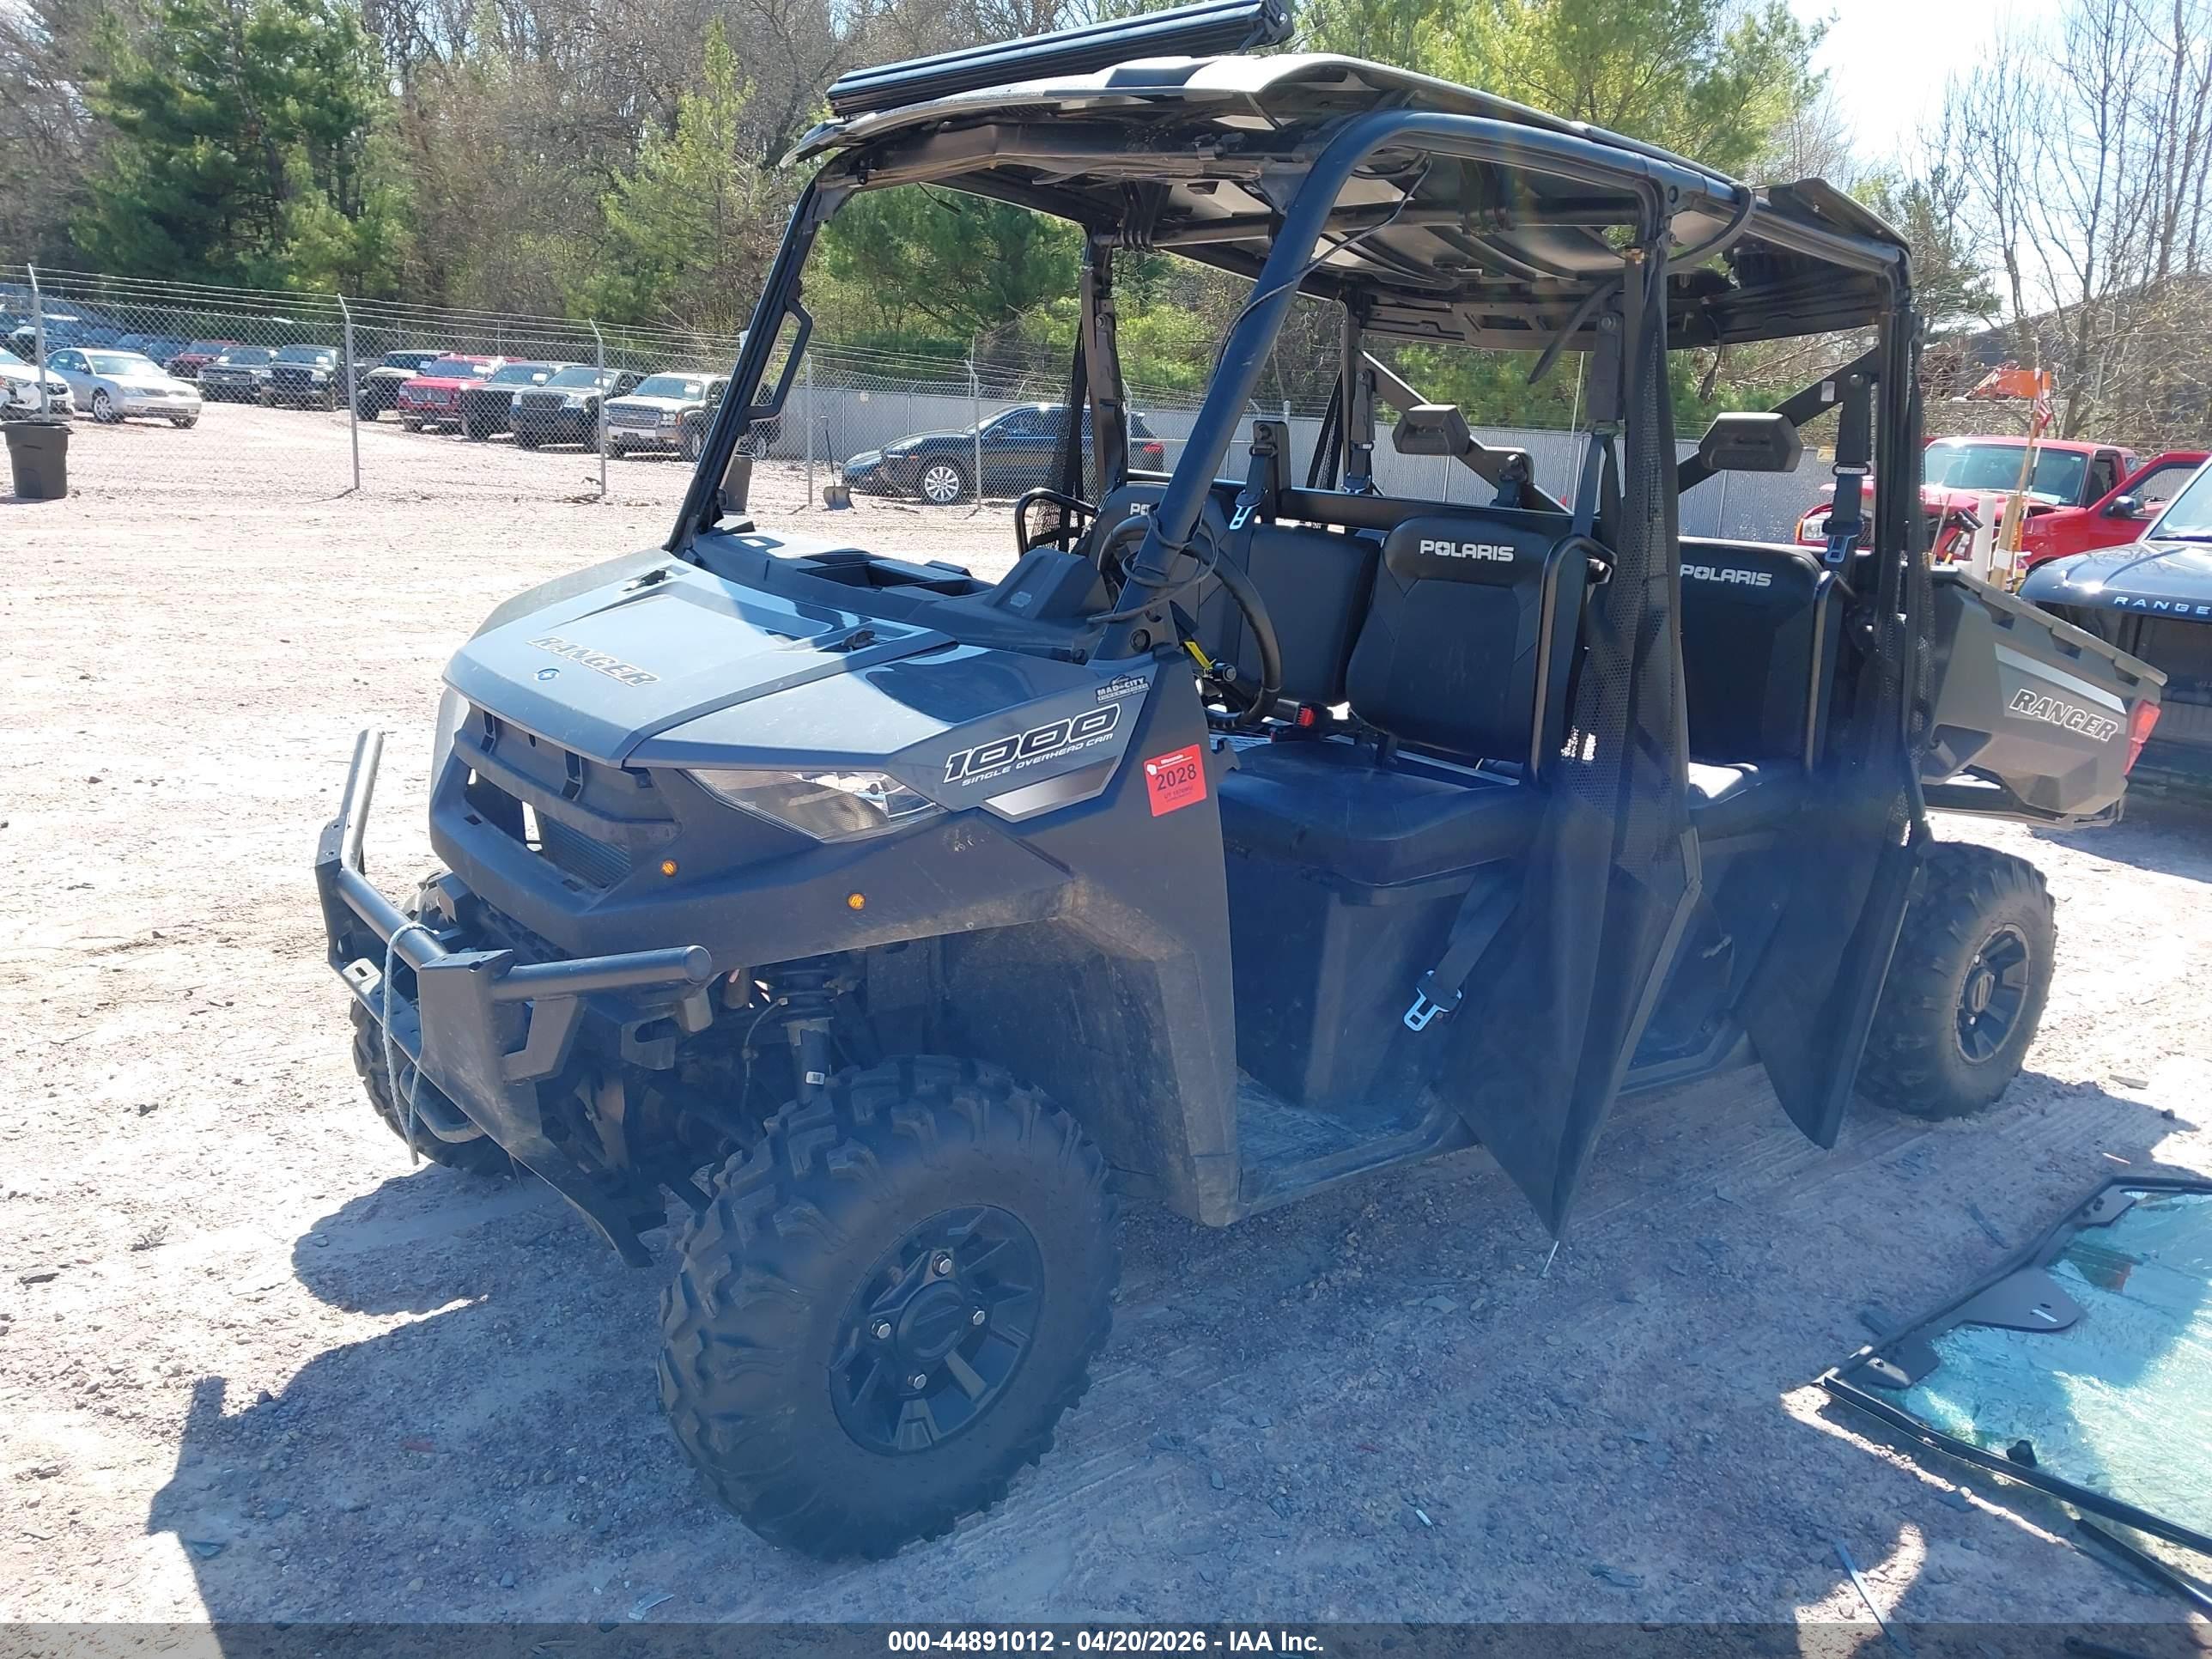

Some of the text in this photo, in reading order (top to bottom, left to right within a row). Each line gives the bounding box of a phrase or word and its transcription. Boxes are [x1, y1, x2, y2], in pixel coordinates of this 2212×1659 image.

[1419, 539, 1514, 562] POLARIS
[1680, 563, 1772, 586] POLARIS
[2113, 596, 2211, 615] RANGE
[526, 635, 660, 687] RANGER
[2009, 688, 2118, 742] RANGER
[943, 703, 1121, 784] 1000
[961, 732, 1114, 787] SINGLE OVERHEAD CAM
[1155, 763, 1197, 791] 2028
